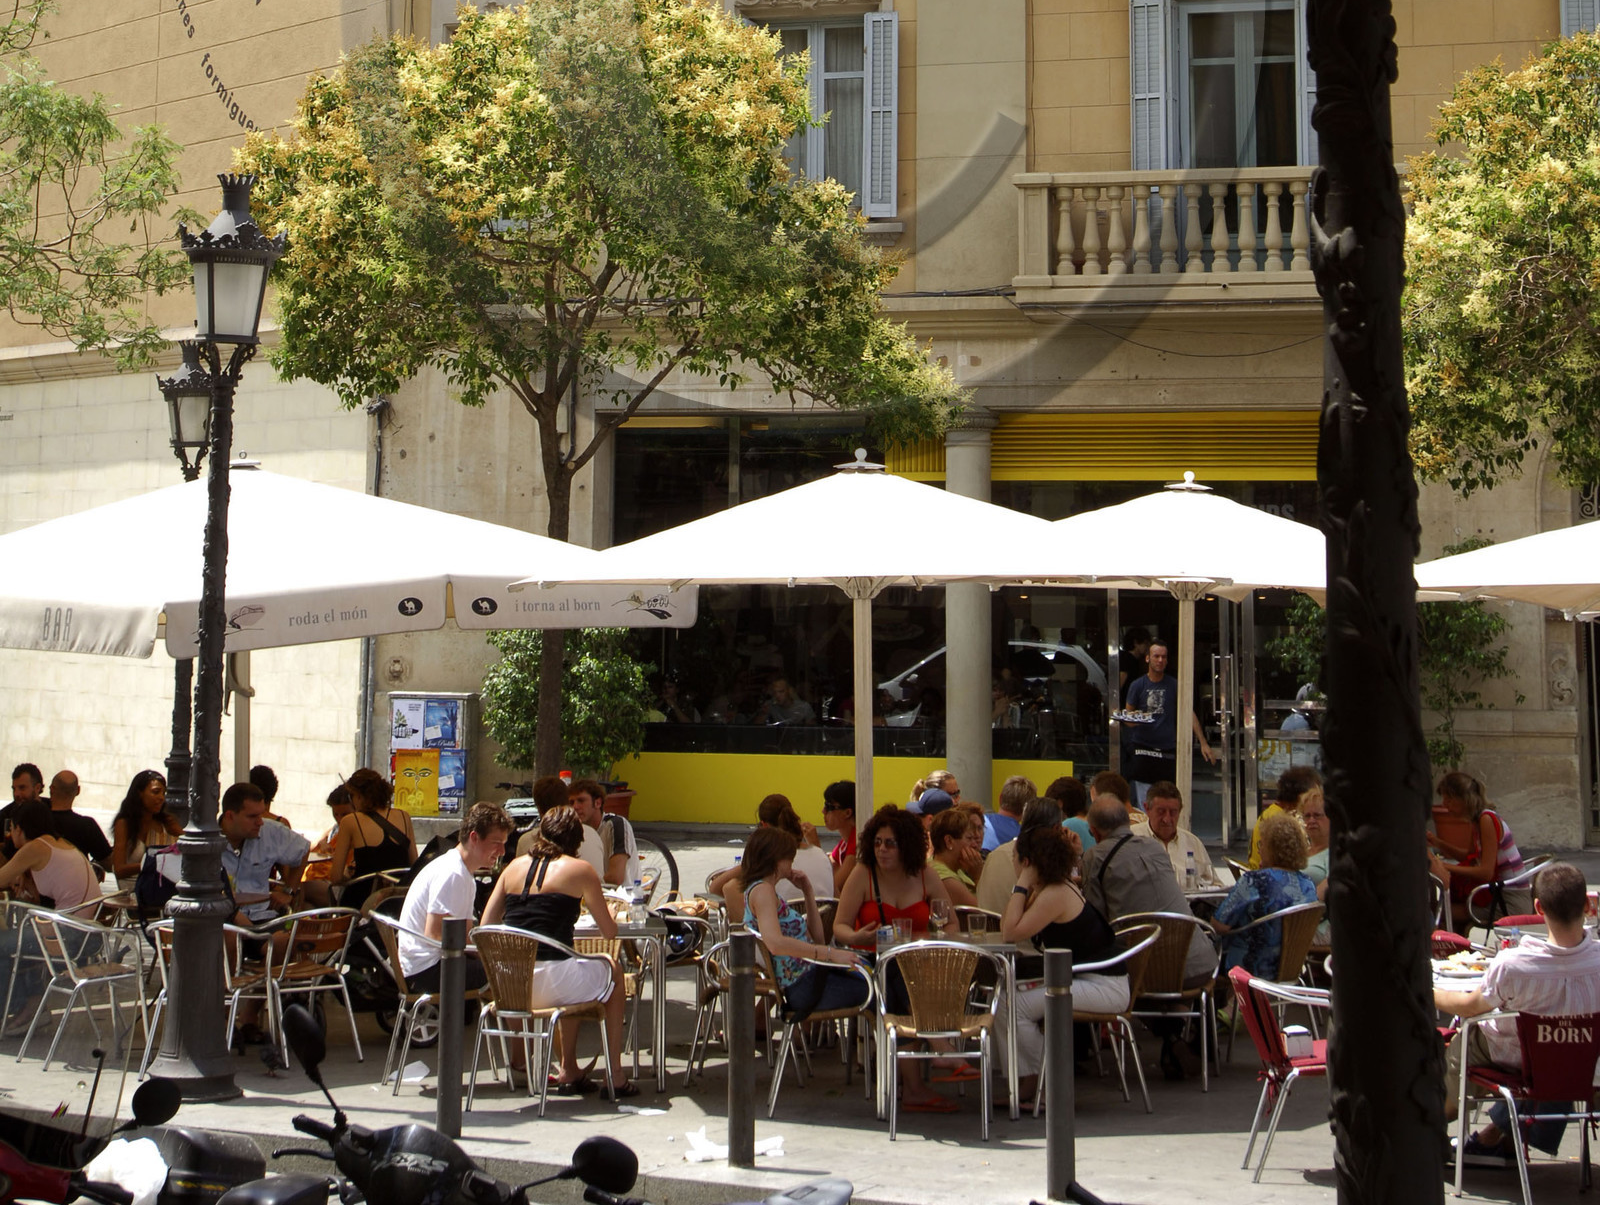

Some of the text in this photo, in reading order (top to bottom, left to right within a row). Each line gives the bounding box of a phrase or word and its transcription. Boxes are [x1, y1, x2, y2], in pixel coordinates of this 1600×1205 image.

[201, 53, 262, 133] formigue
[288, 605, 368, 627] roda el món
[522, 601, 555, 612] torna
[559, 598, 570, 612] al
[574, 598, 601, 612] born
[42, 607, 73, 642] BAR
[1537, 1024, 1593, 1044] BORN
